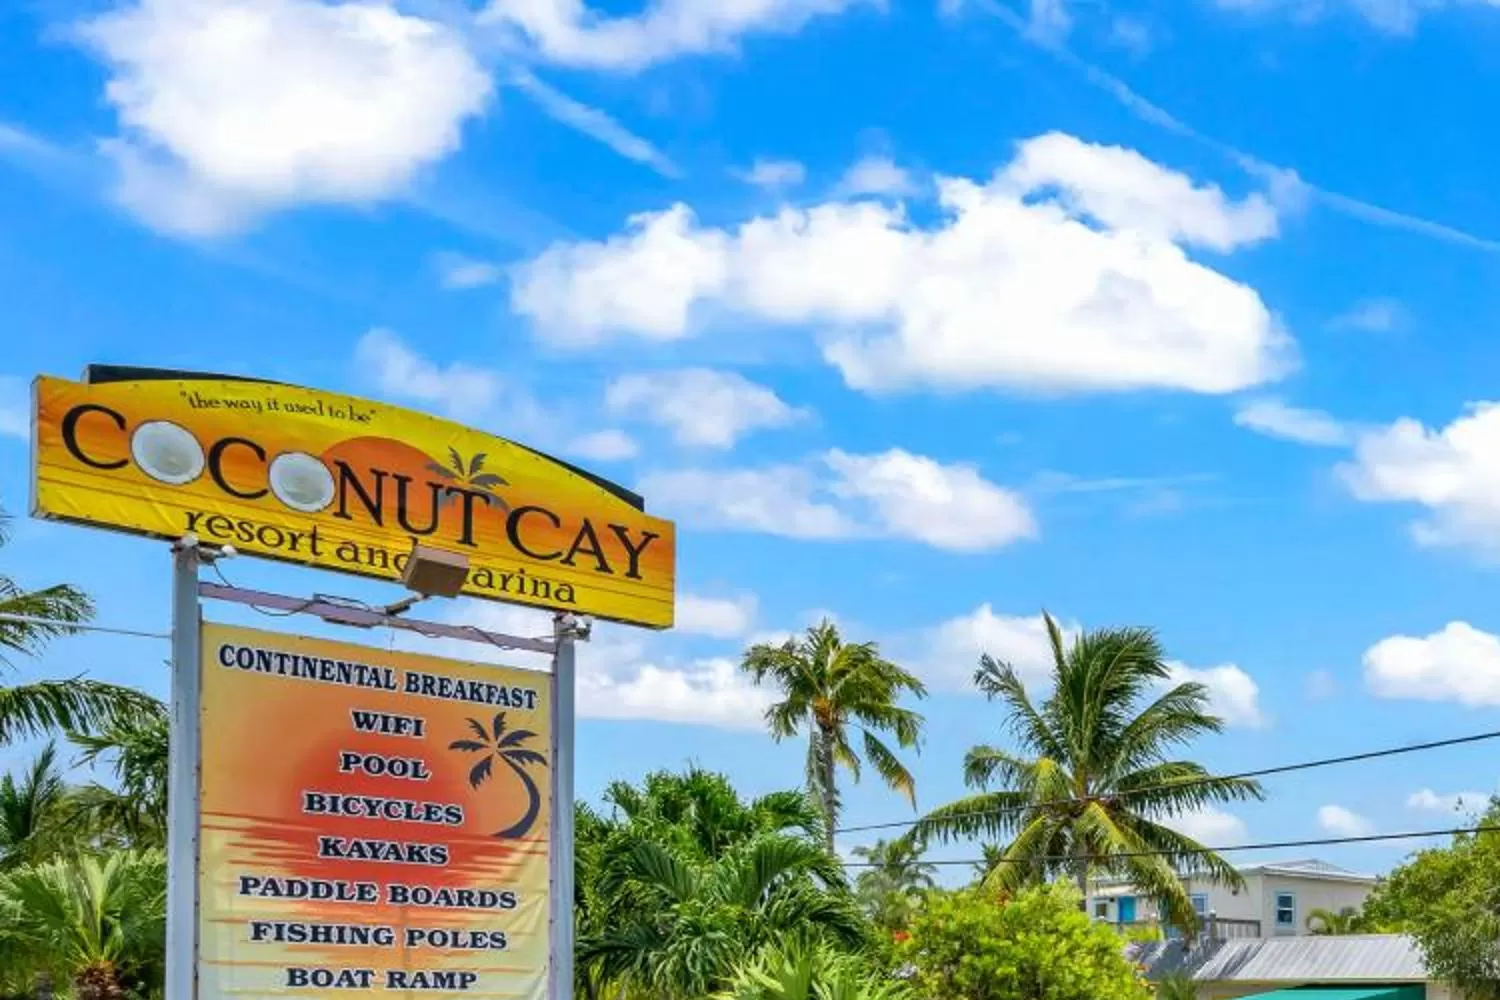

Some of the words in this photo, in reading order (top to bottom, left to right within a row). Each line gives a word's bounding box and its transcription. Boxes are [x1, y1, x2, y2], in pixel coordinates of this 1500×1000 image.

[223, 398, 262, 413] way
[266, 397, 280, 411] it
[283, 400, 324, 417] used
[328, 404, 345, 420] to
[61, 403, 491, 549] COCONUT
[505, 504, 659, 581] CAY
[184, 509, 323, 557] resort
[218, 643, 396, 691] CONTINENTAL
[404, 670, 538, 710] BREAKFAST
[351, 709, 424, 737] WIFI
[339, 751, 430, 780] POOL
[303, 792, 463, 825] BICYCLES
[319, 836, 449, 865] KAYAKS
[239, 876, 377, 903] PADDLE
[388, 884, 518, 910] BOARDS
[251, 921, 394, 946] FISHING
[406, 929, 508, 950] POLES
[286, 967, 374, 988] BOAT
[386, 971, 477, 990] RAMP
